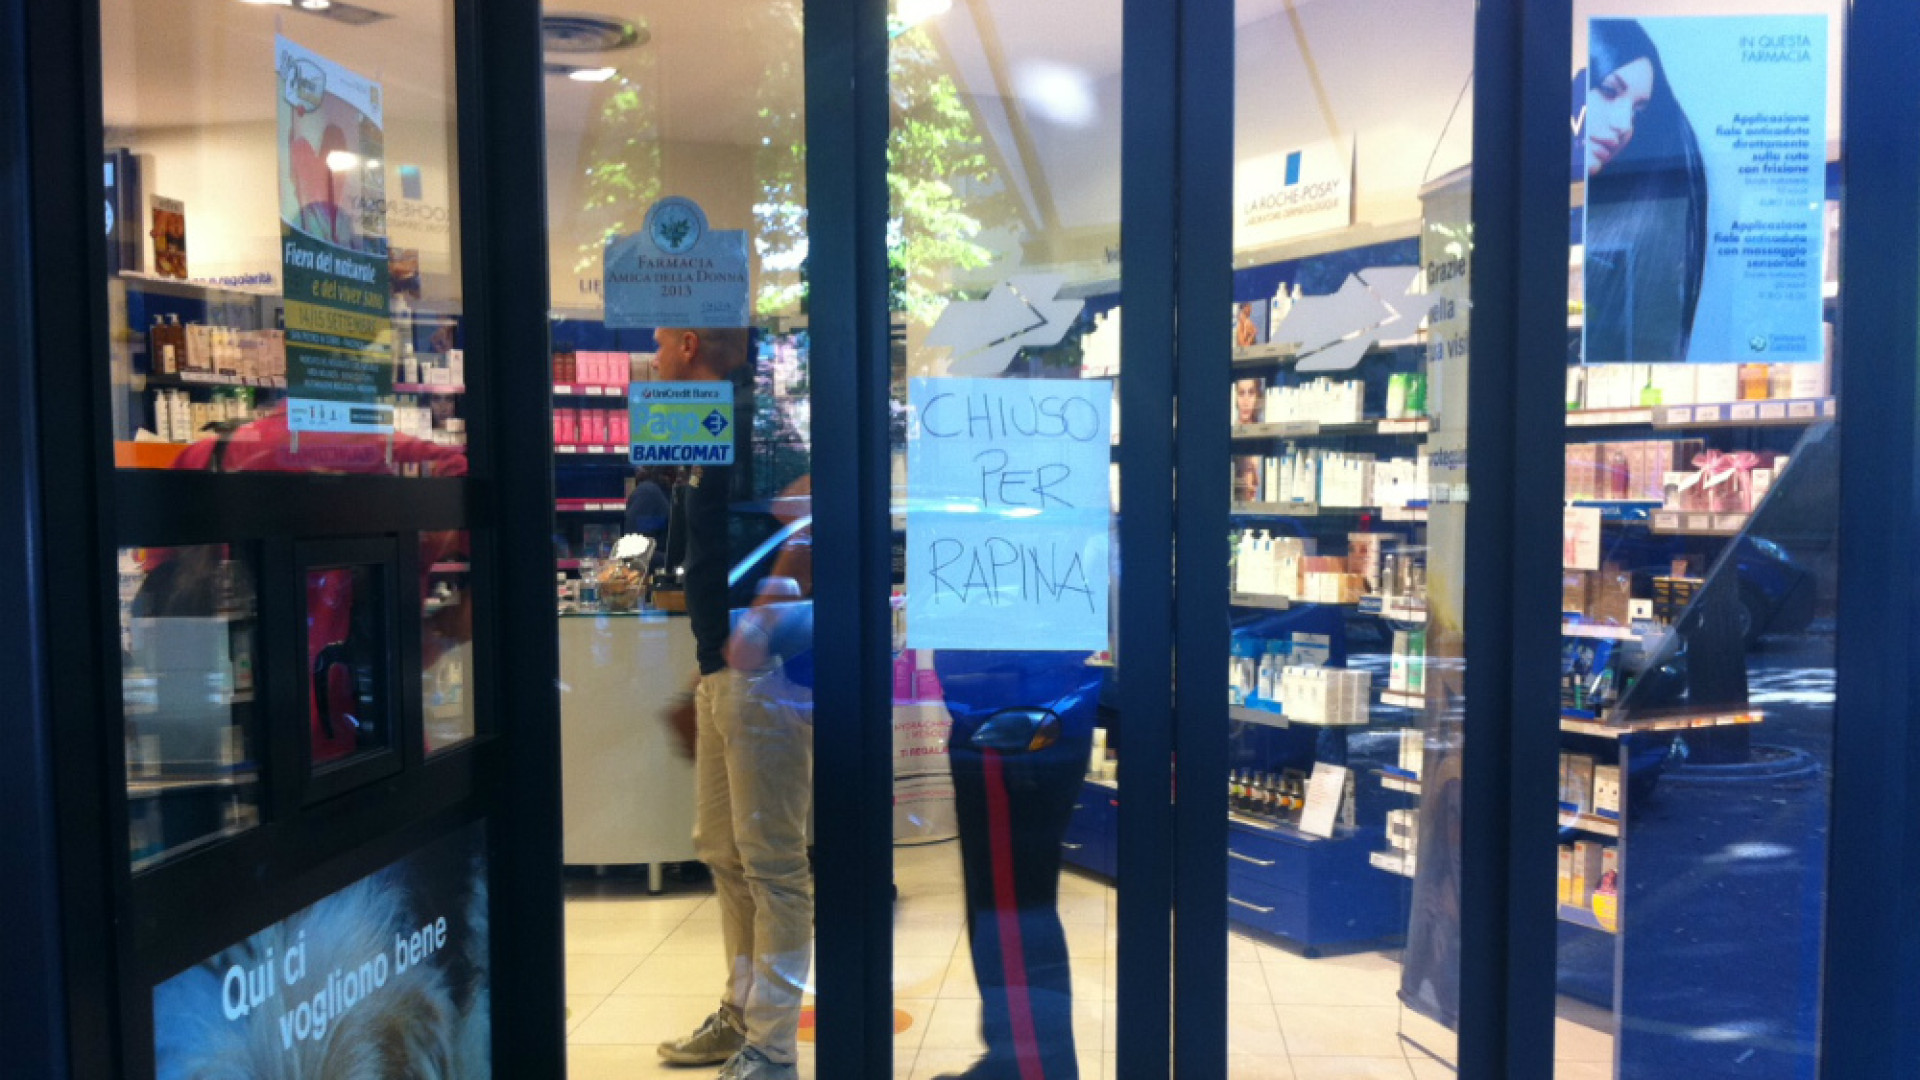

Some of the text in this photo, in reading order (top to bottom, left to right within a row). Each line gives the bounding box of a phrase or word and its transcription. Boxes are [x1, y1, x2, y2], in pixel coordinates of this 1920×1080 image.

[1739, 35, 1811, 48] IN QUESTA
[1741, 50, 1811, 63] FARMACIA
[1733, 113, 1810, 125] Applicazione
[1716, 125, 1810, 136] fiale anticaduta
[1732, 138, 1810, 149] direttamente
[1752, 151, 1809, 161] sulla cute
[1738, 163, 1809, 174] con frizione
[1243, 178, 1340, 215] LA ROCHE-POSAY
[1732, 220, 1807, 232] Applicazione
[1714, 232, 1807, 243] fiale anticaduta
[1718, 245, 1807, 257] con massaggio
[286, 242, 377, 284] Fiera del naturale
[638, 255, 713, 270] FARMACIA
[1747, 258, 1807, 268] sensoriale
[608, 270, 745, 283] AMICA DELLA DONNA
[1428, 256, 1466, 285] Grazie
[313, 279, 385, 310] e del viver sano
[660, 284, 692, 297] 2013
[652, 388, 719, 398] UniCredit Banca
[633, 404, 700, 442] Pago
[921, 392, 1099, 442] CHIUSO
[633, 444, 731, 461] BANCOMAT
[973, 448, 1074, 509] PER
[929, 536, 1095, 615] RAPINA
[222, 930, 306, 1020] Qui ci
[279, 916, 447, 1049] vogliono bene
